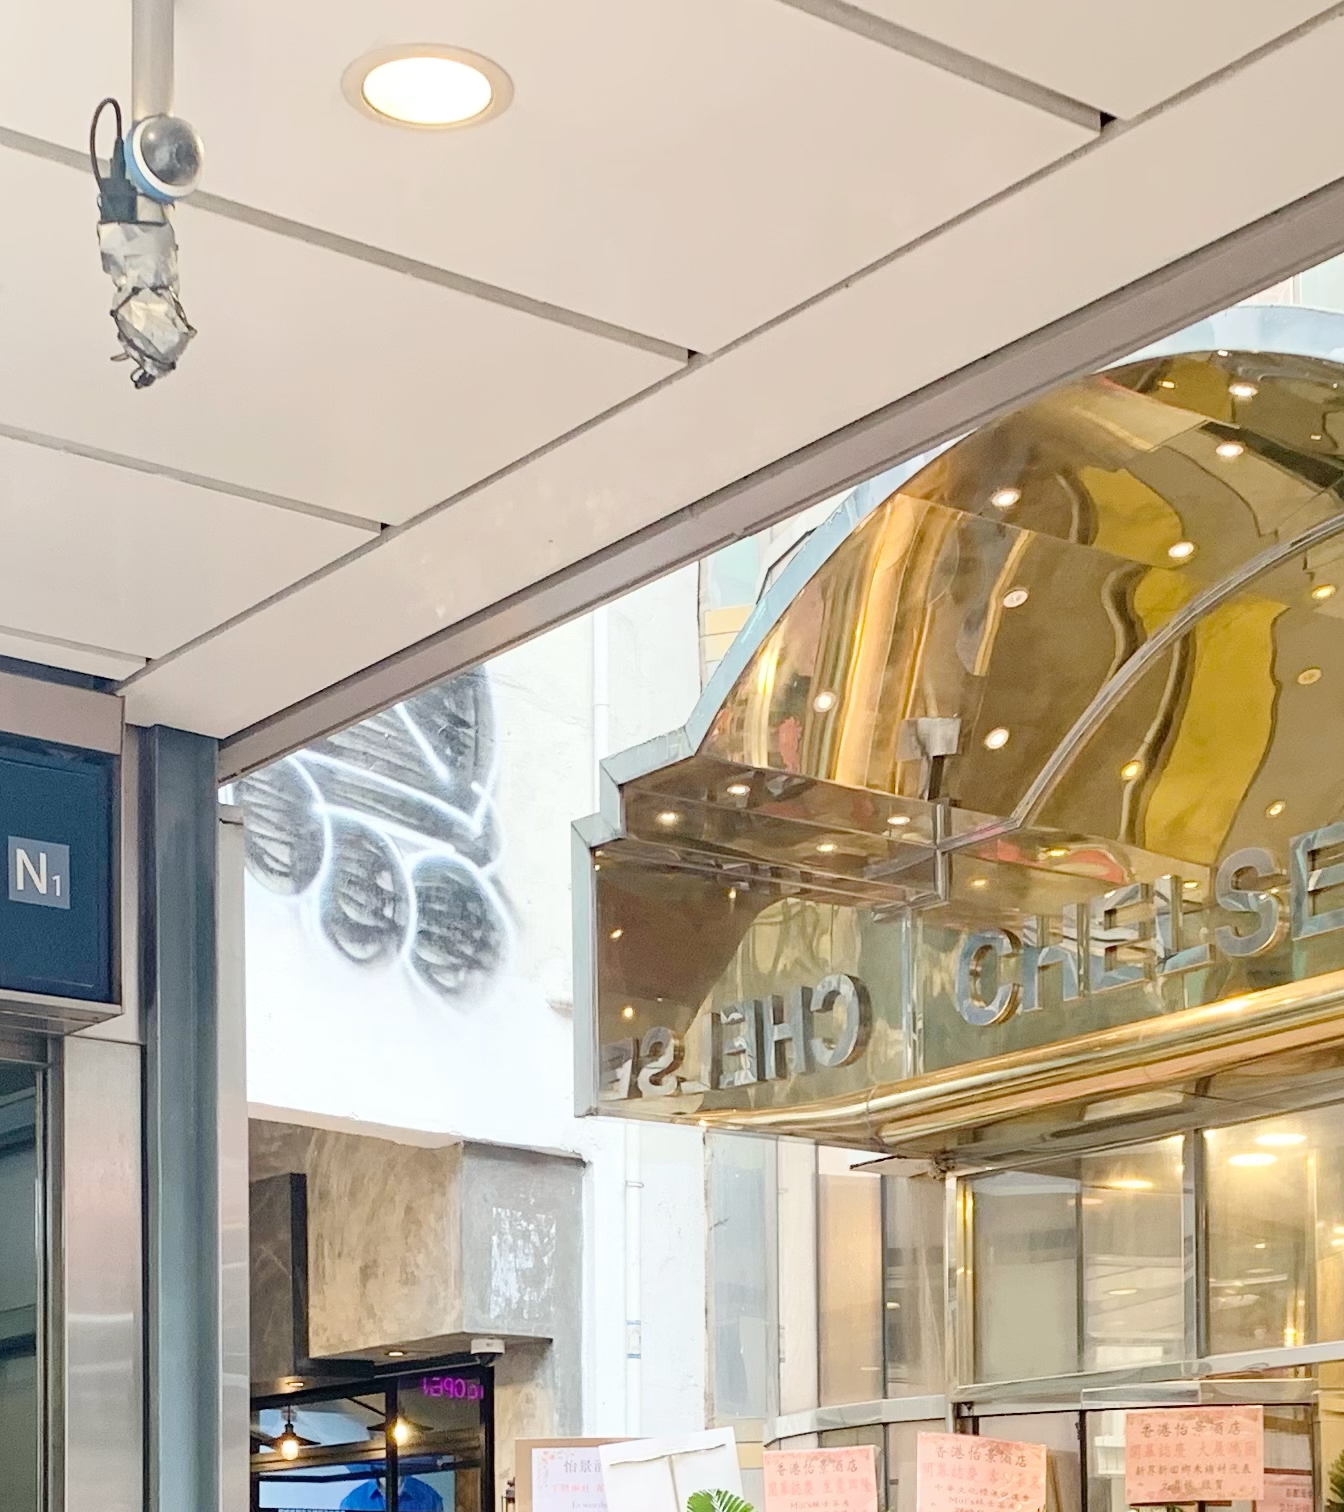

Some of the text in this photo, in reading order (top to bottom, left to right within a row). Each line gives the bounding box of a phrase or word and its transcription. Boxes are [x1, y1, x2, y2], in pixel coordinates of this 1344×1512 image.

[1141, 1420, 1242, 1438] 香港怡景酒店
